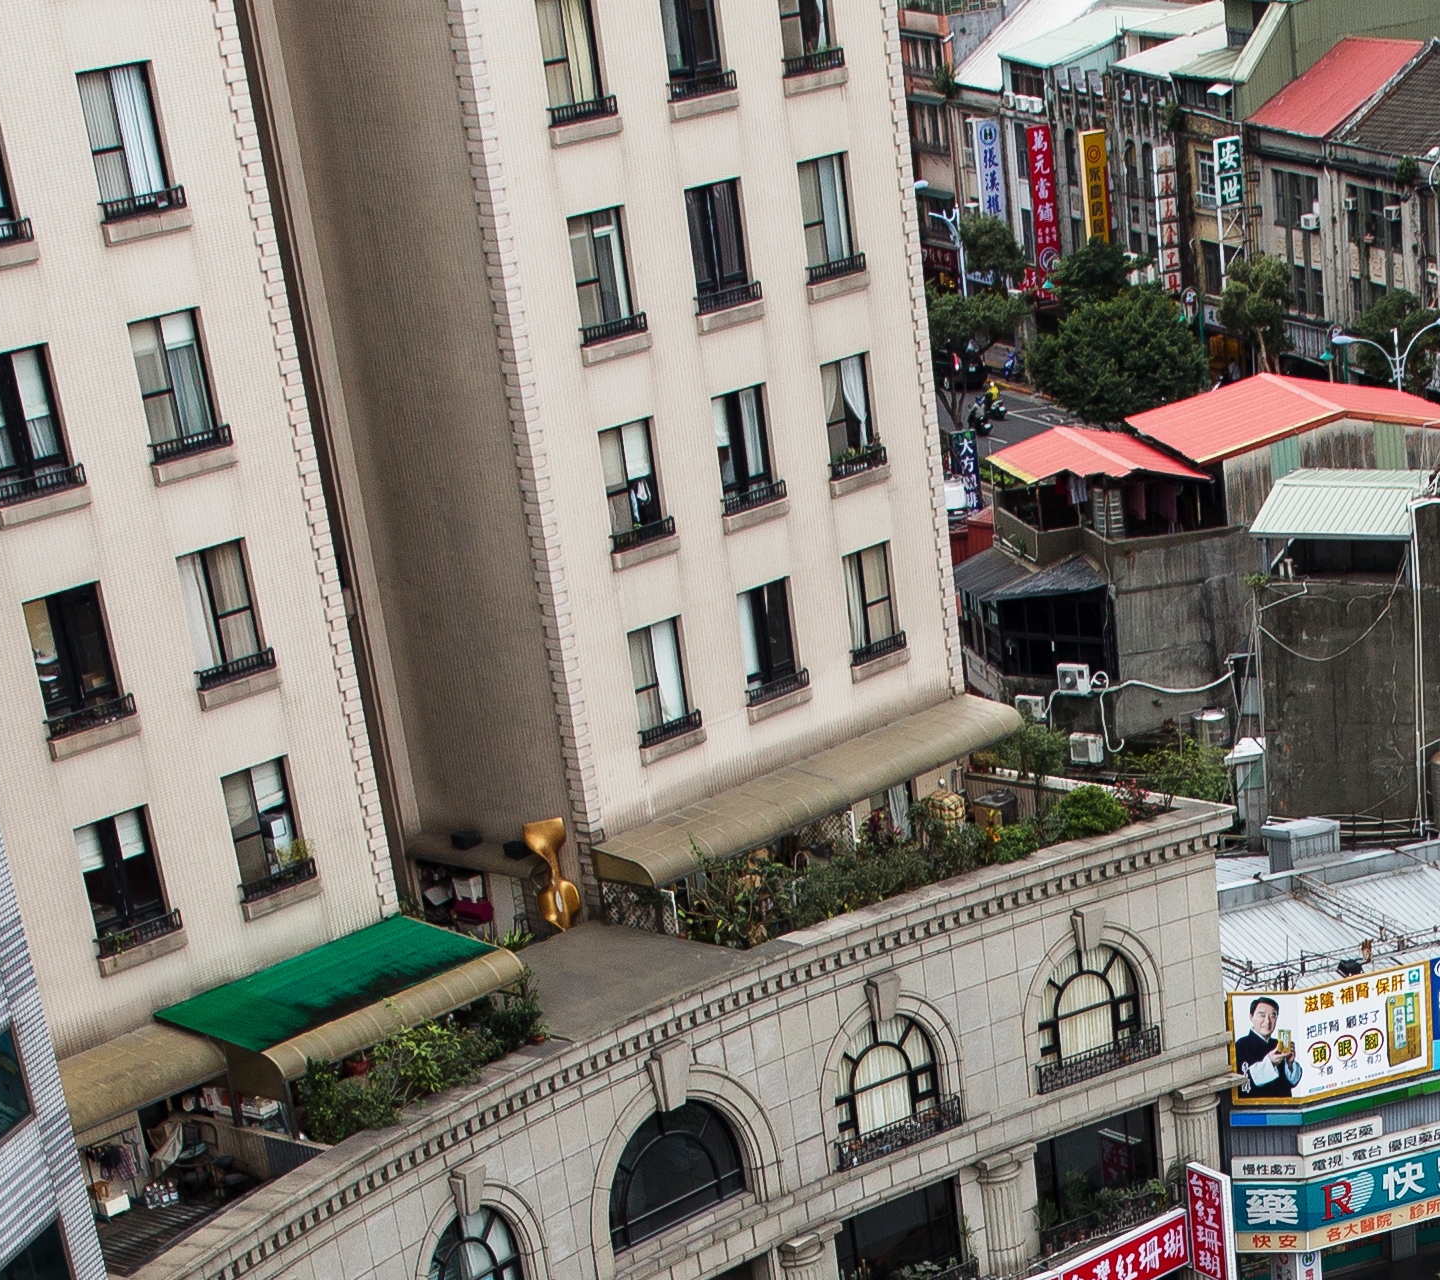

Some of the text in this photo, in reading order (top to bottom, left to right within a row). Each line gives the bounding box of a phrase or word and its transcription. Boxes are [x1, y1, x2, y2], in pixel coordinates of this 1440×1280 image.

[1218, 142, 1241, 204] 安世
[1312, 1122, 1375, 1150] 各國名藥
[1241, 1163, 1298, 1176] 慢性處方
[1245, 1187, 1300, 1226] 藥
[1190, 1172, 1223, 1280] 台灣紅珊瑚
[1252, 1233, 1298, 1249] 快安
